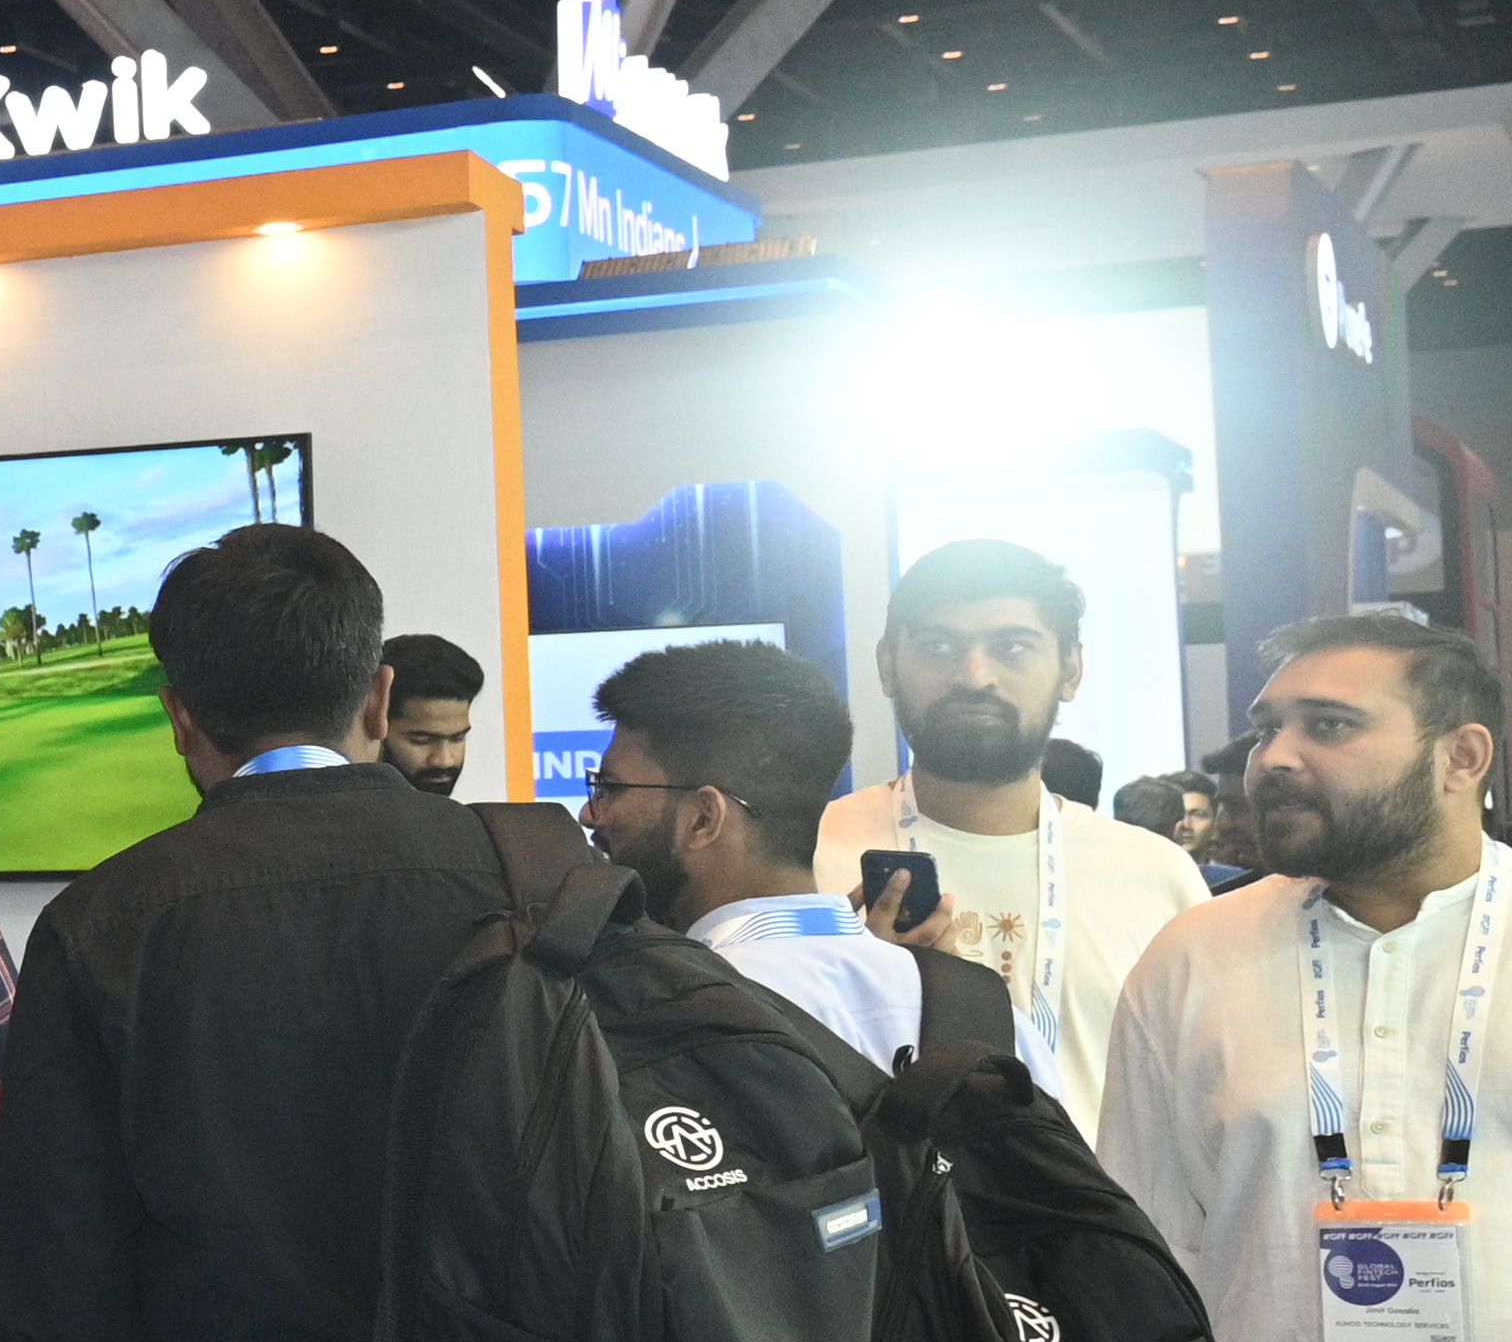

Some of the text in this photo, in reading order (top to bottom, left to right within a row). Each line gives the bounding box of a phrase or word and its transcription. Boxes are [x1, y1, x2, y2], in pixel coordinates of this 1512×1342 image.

[577, 170, 613, 247] Mn
[685, 1169, 748, 1192] ACCOSIS
[1409, 1277, 1455, 1288] Perfios
